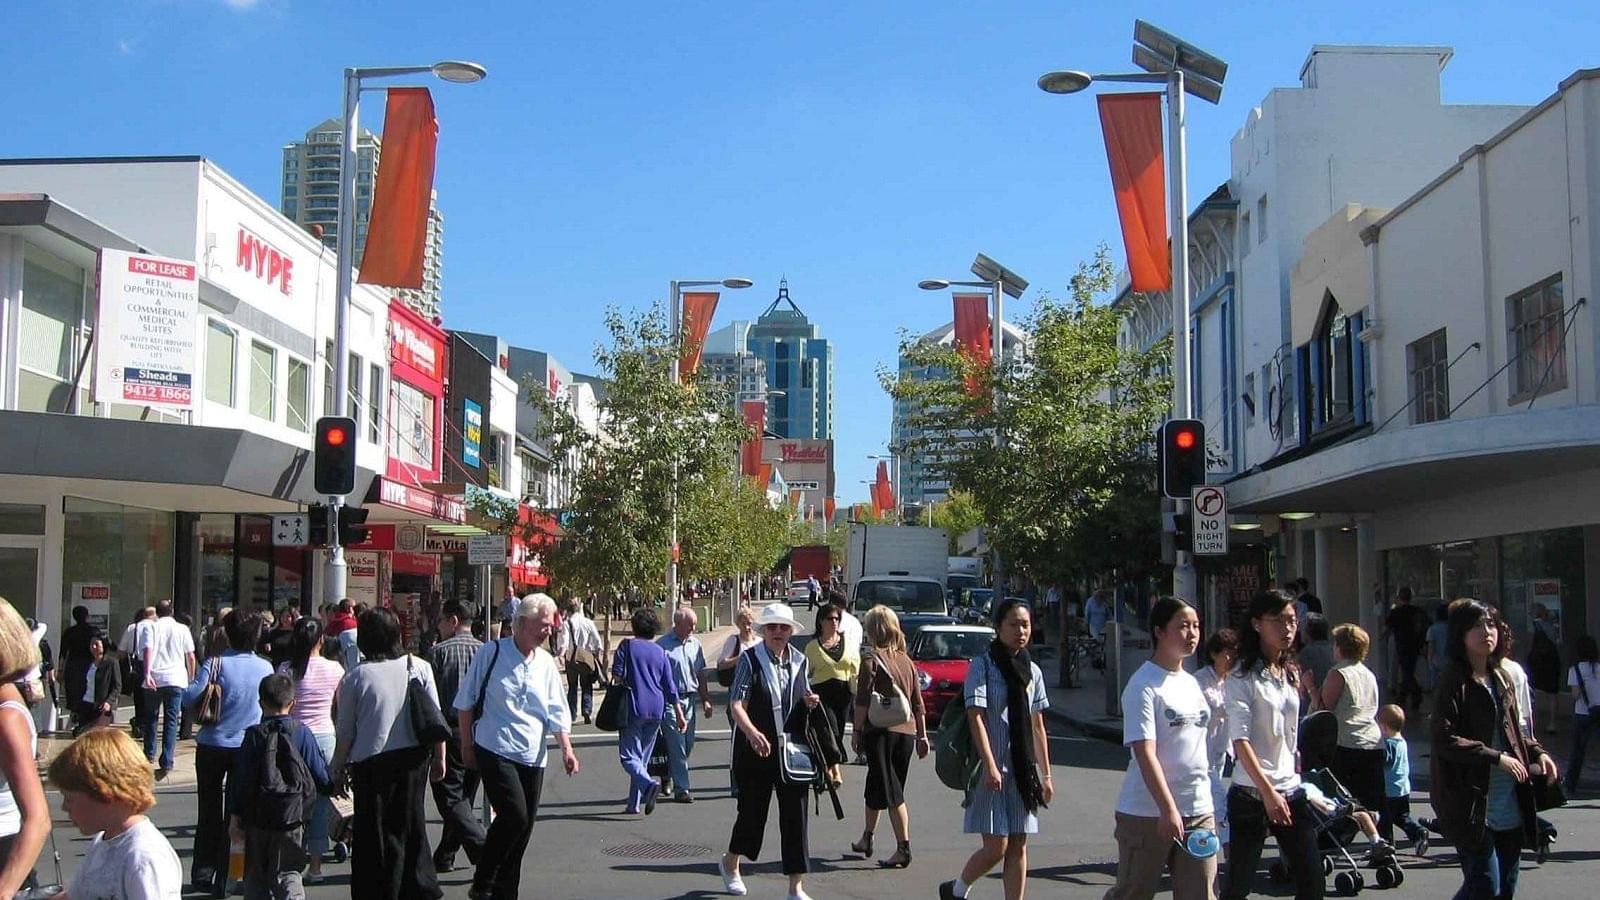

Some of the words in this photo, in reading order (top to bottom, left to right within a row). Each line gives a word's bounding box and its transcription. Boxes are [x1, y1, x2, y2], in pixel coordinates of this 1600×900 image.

[135, 259, 157, 273] FOR
[160, 262, 188, 277] LEASE
[237, 229, 293, 296] HYPE
[146, 278, 172, 289] RETAIL
[124, 285, 194, 301] OPPORTUNITIES
[155, 298, 162, 306] &
[138, 314, 177, 327] MEDICAL
[143, 324, 172, 334] SUITES
[138, 369, 178, 382] Sheads
[125, 384, 157, 397] 9412
[160, 387, 190, 400] 1866
[383, 480, 407, 505] HYPE
[1200, 520, 1219, 530] NO
[1196, 533, 1224, 541] RIGHT
[1198, 542, 1222, 550] TURN
